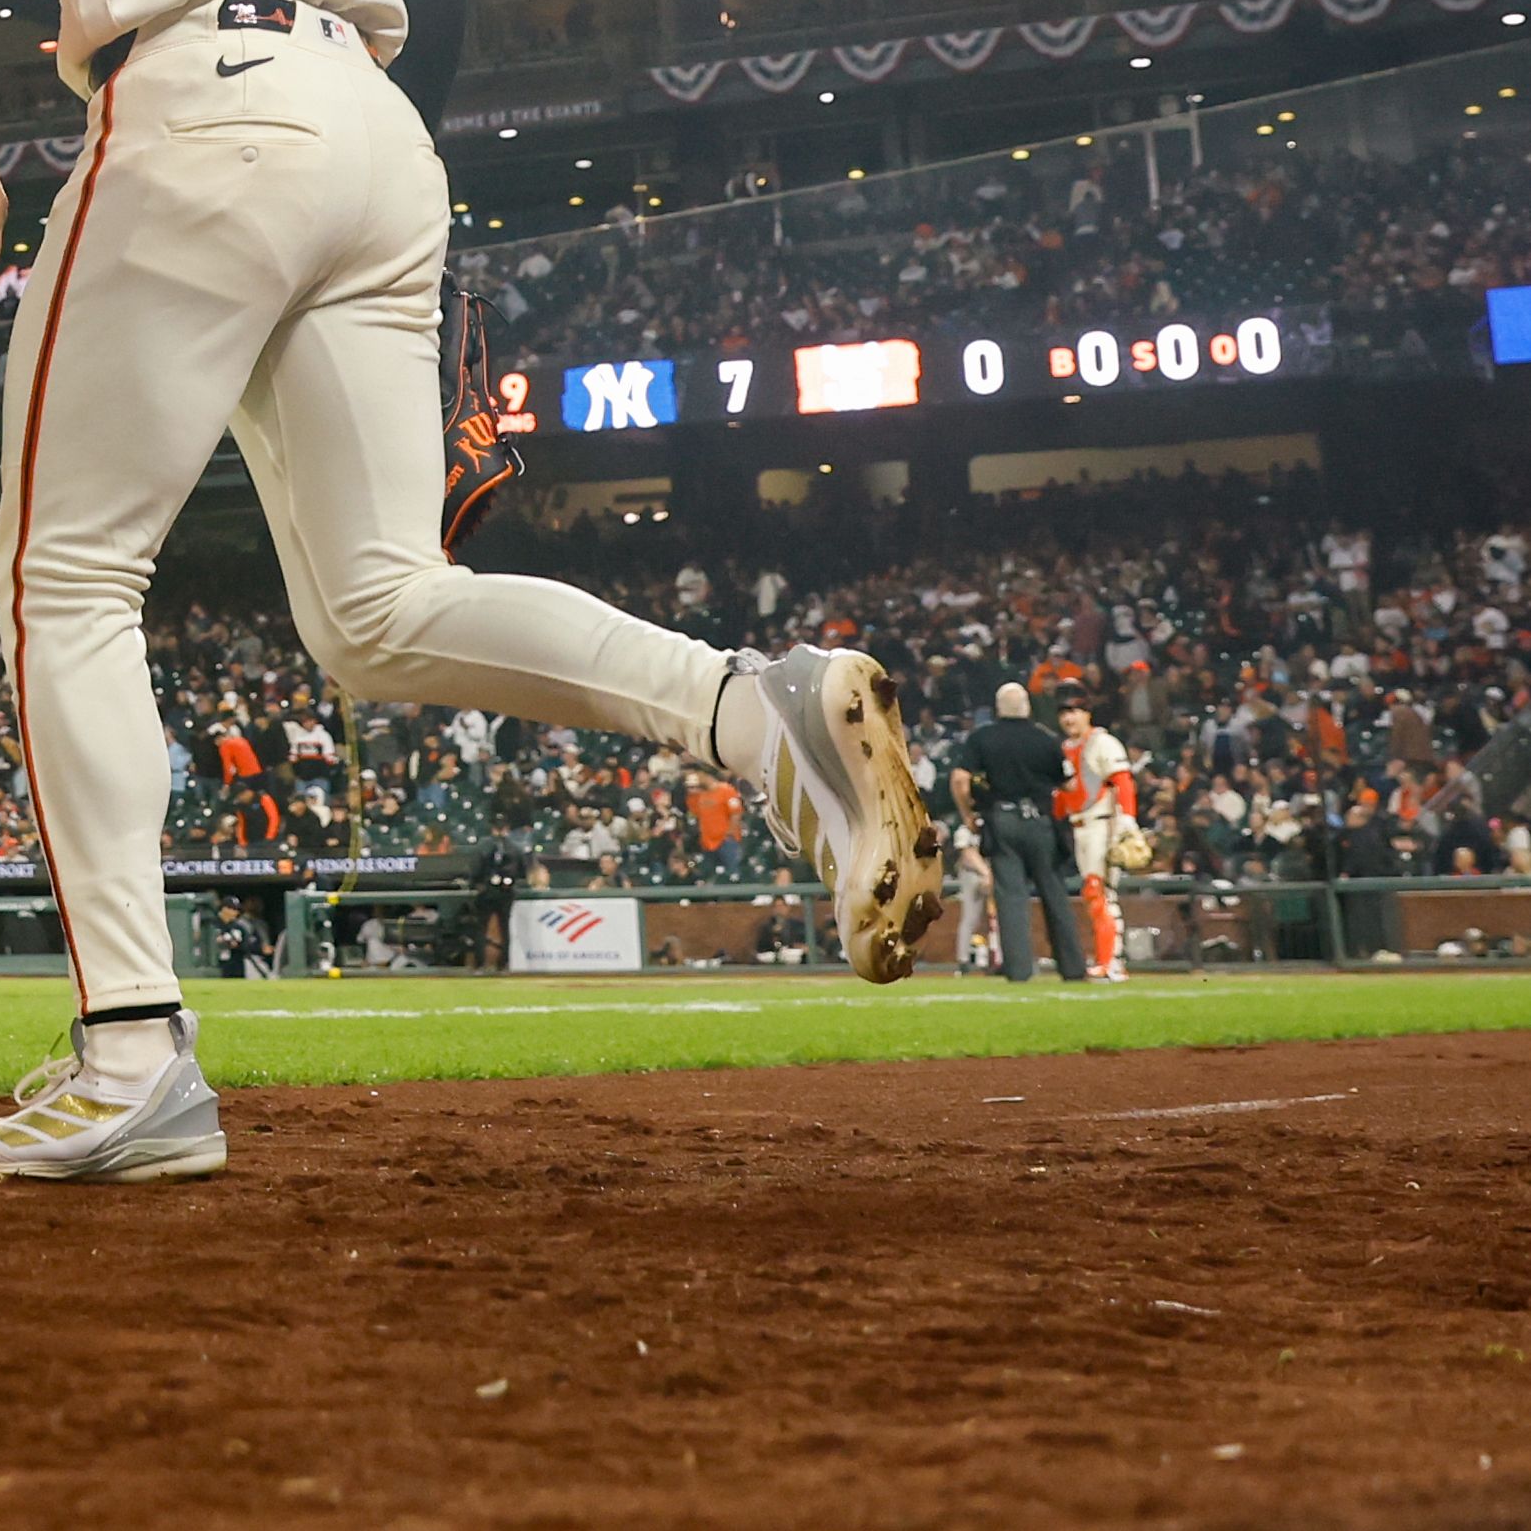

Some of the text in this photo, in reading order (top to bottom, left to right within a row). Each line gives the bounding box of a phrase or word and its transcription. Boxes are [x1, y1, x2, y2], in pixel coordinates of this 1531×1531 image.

[718, 359, 754, 414] 7
[962, 338, 1005, 396] 0
[499, 372, 530, 412] 9
[161, 860, 218, 876] CACHE
[220, 859, 276, 875] CREEK
